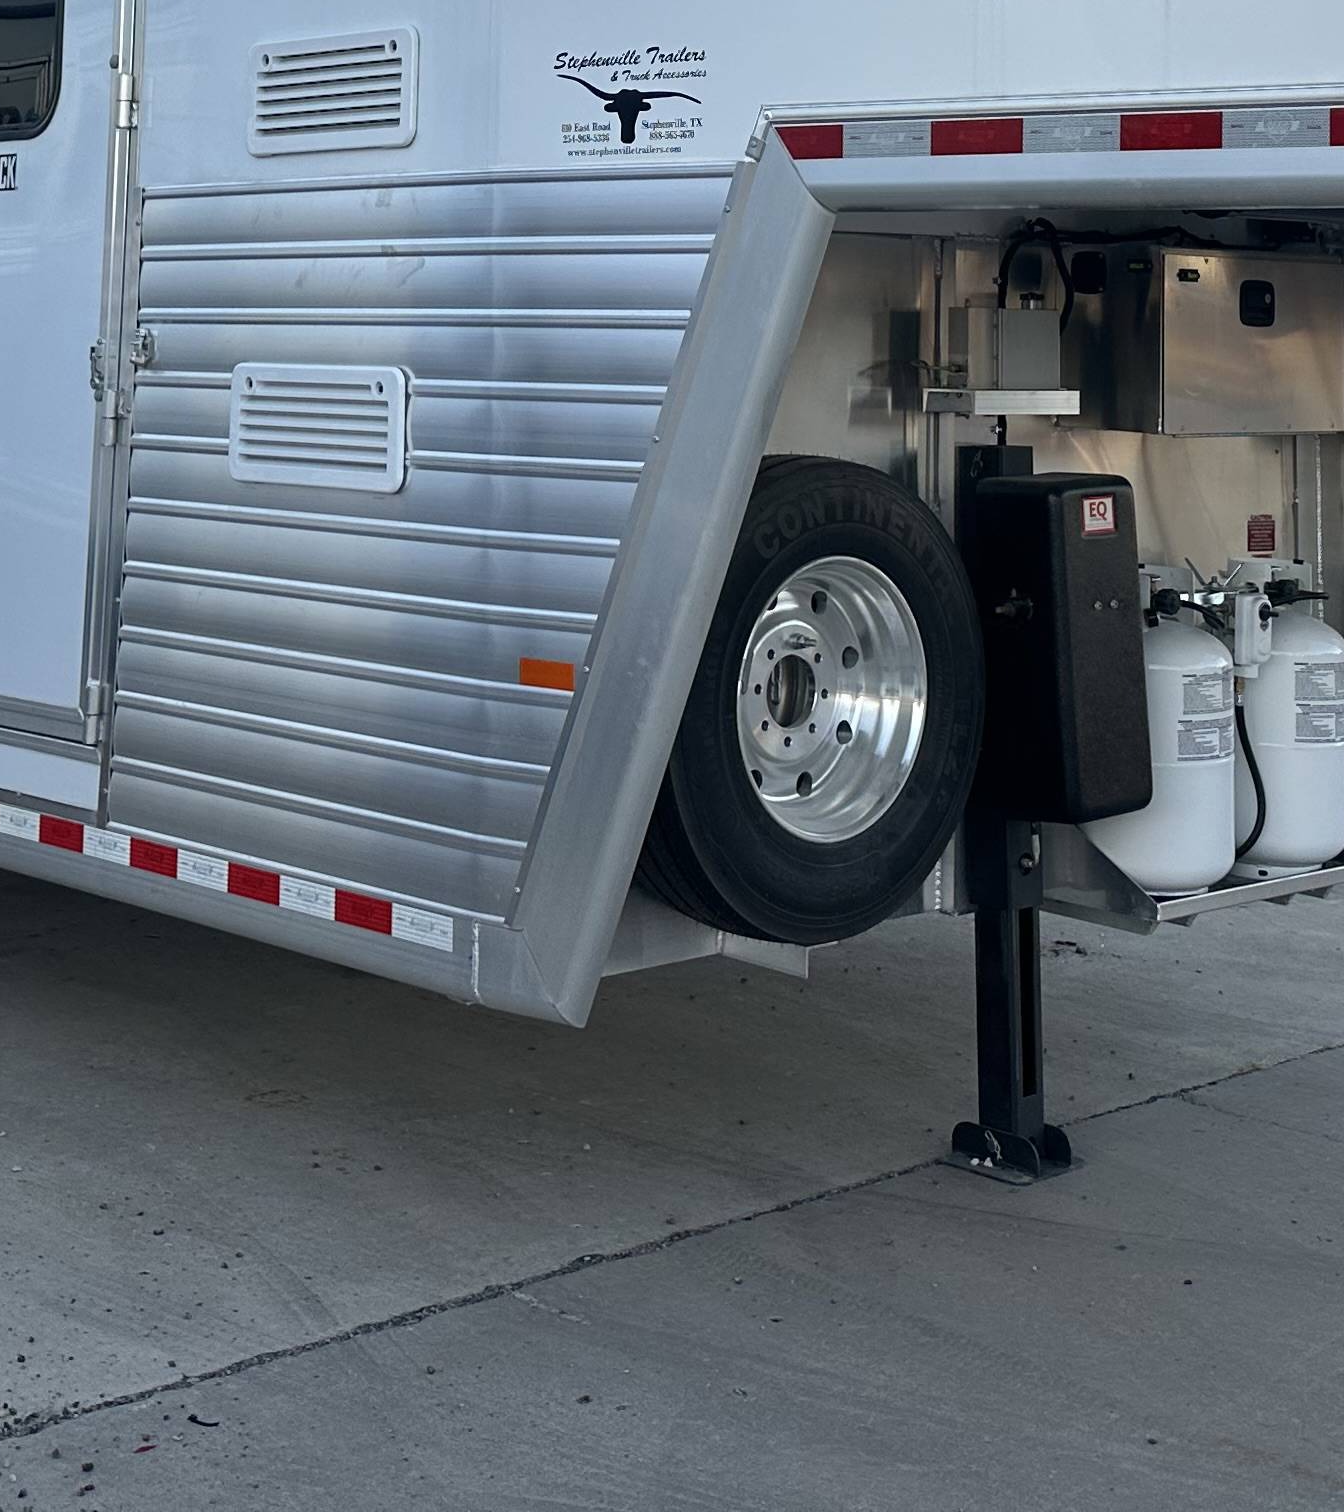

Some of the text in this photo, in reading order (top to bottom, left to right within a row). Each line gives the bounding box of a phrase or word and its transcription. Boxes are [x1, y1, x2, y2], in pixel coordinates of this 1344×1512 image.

[553, 46, 706, 72] Stephenville Trailers
[610, 67, 707, 82] & Truck Accessories
[1089, 501, 1107, 521] EQ
